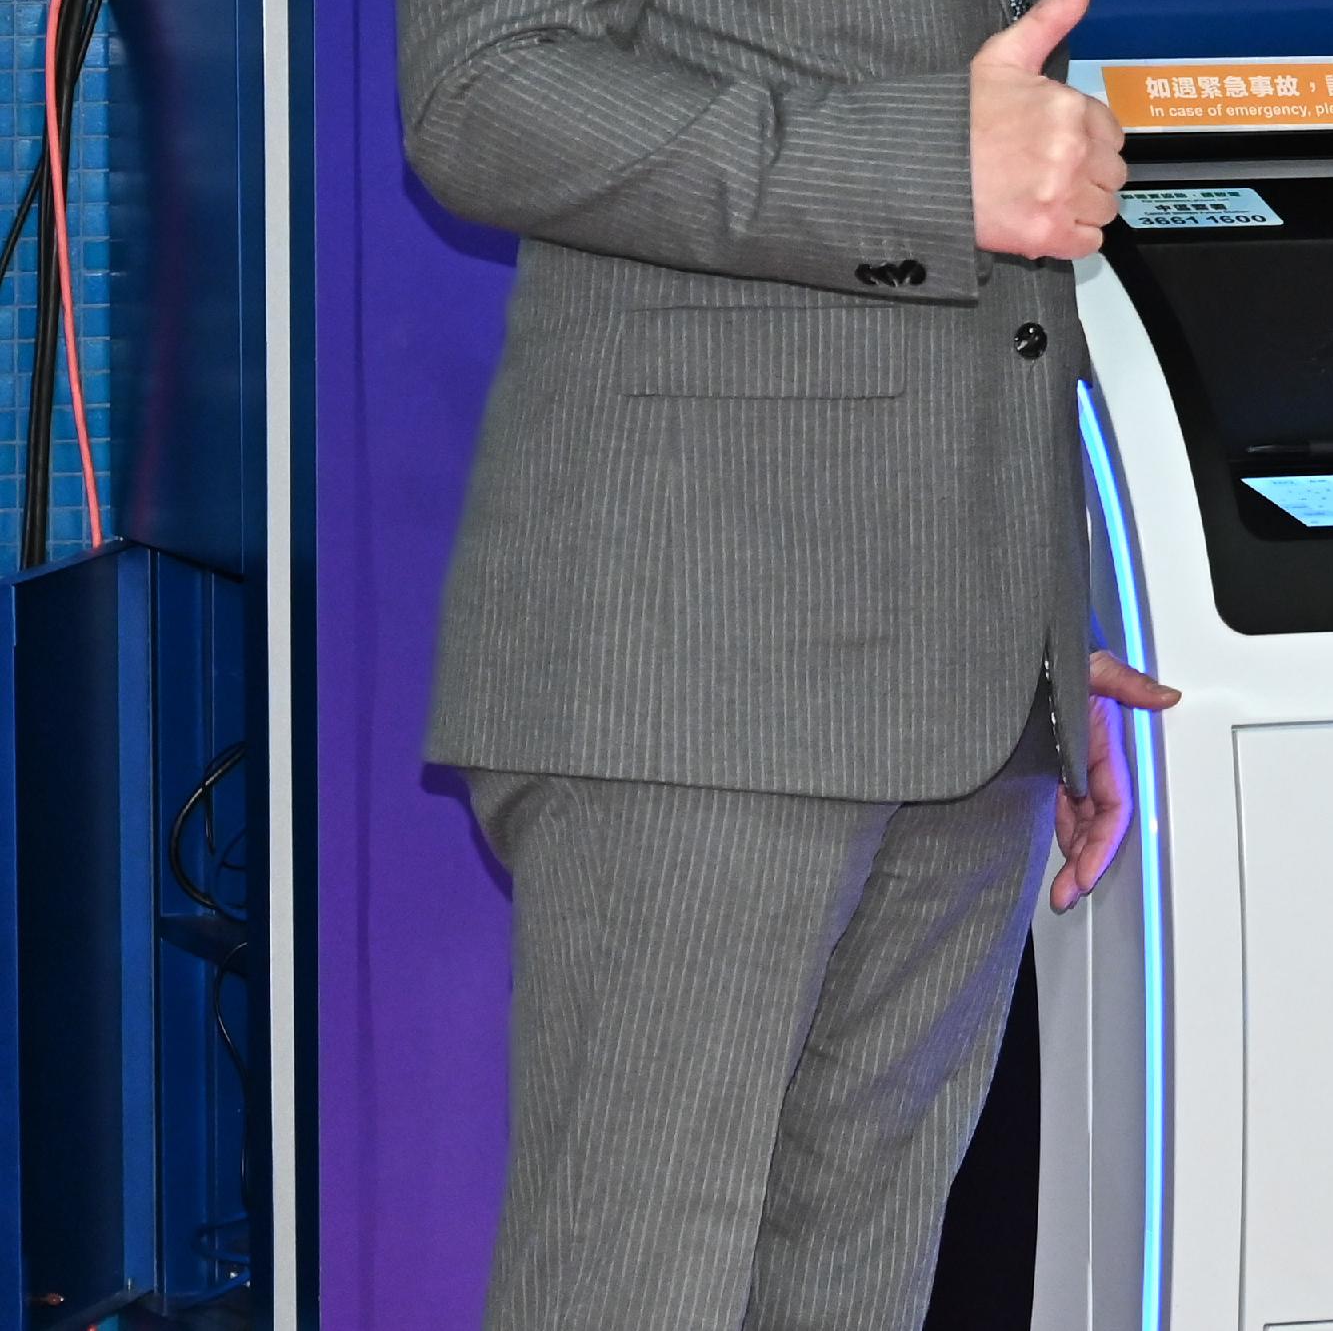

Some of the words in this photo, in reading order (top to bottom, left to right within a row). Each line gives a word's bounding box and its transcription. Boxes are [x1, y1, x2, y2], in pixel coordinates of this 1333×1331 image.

[1150, 106, 1164, 117] In
[1167, 107, 1203, 117] case
[1207, 104, 1222, 116] of
[1226, 105, 1311, 119] emergency,
